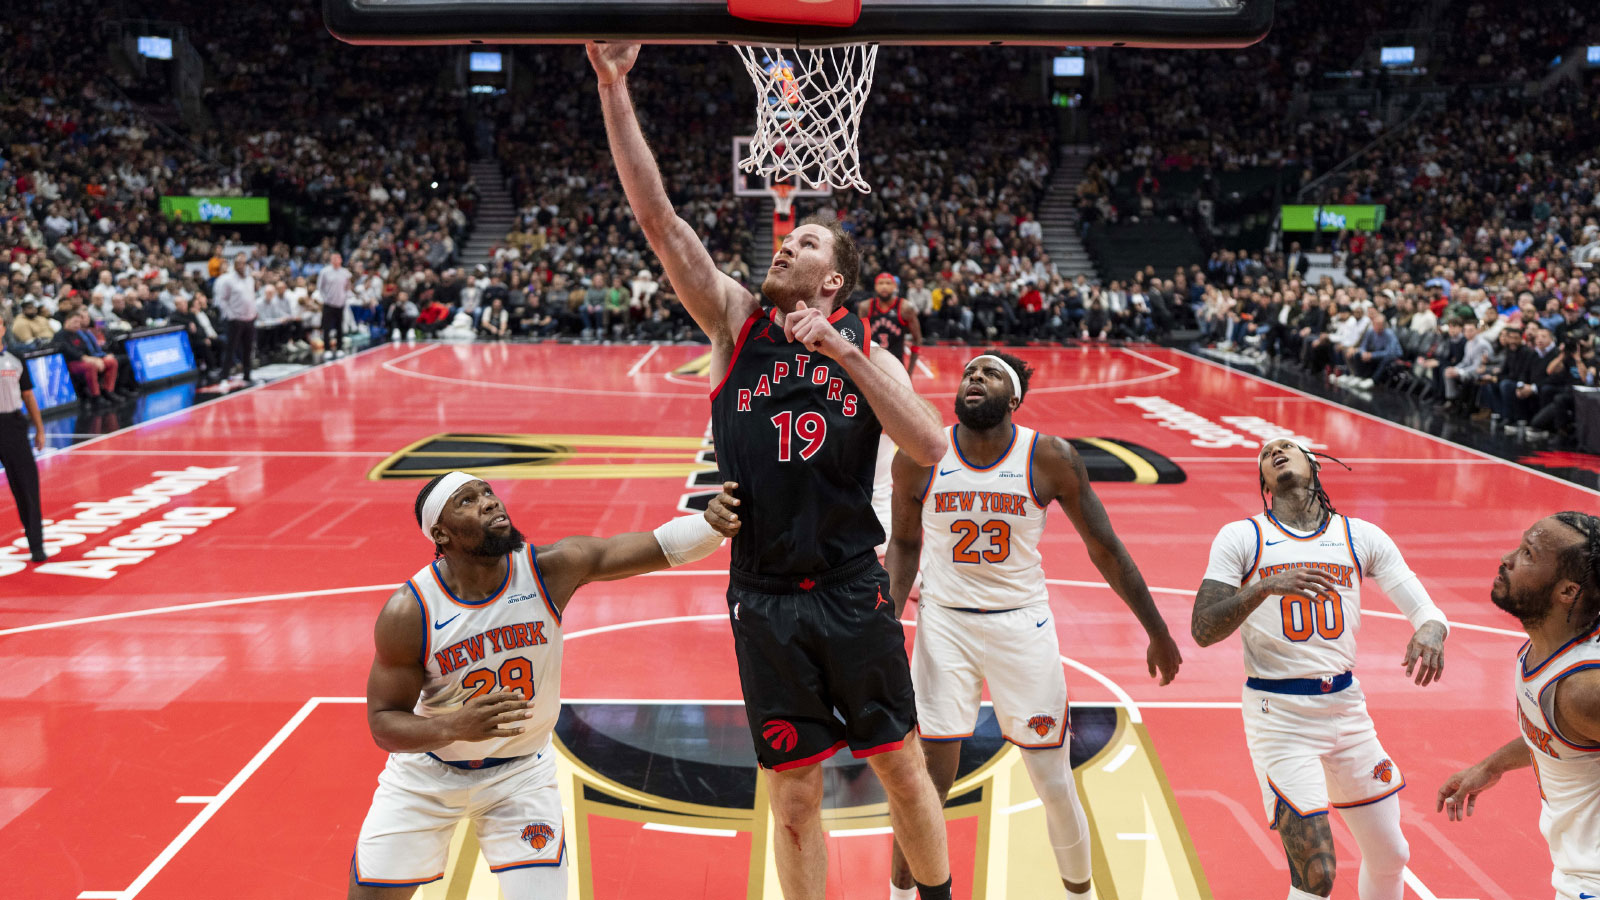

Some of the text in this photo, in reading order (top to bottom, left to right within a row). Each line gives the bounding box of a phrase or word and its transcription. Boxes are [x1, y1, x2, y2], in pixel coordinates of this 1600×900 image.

[737, 354, 857, 417] RAPTORS
[771, 411, 827, 461] 19
[935, 491, 1027, 517] NEW YORK
[34, 506, 236, 579] Arena
[950, 519, 1011, 564] 23
[1280, 589, 1344, 642] 00
[434, 620, 548, 676] NEW YORK
[461, 656, 536, 705] 28
[521, 824, 555, 841] KNICKS
